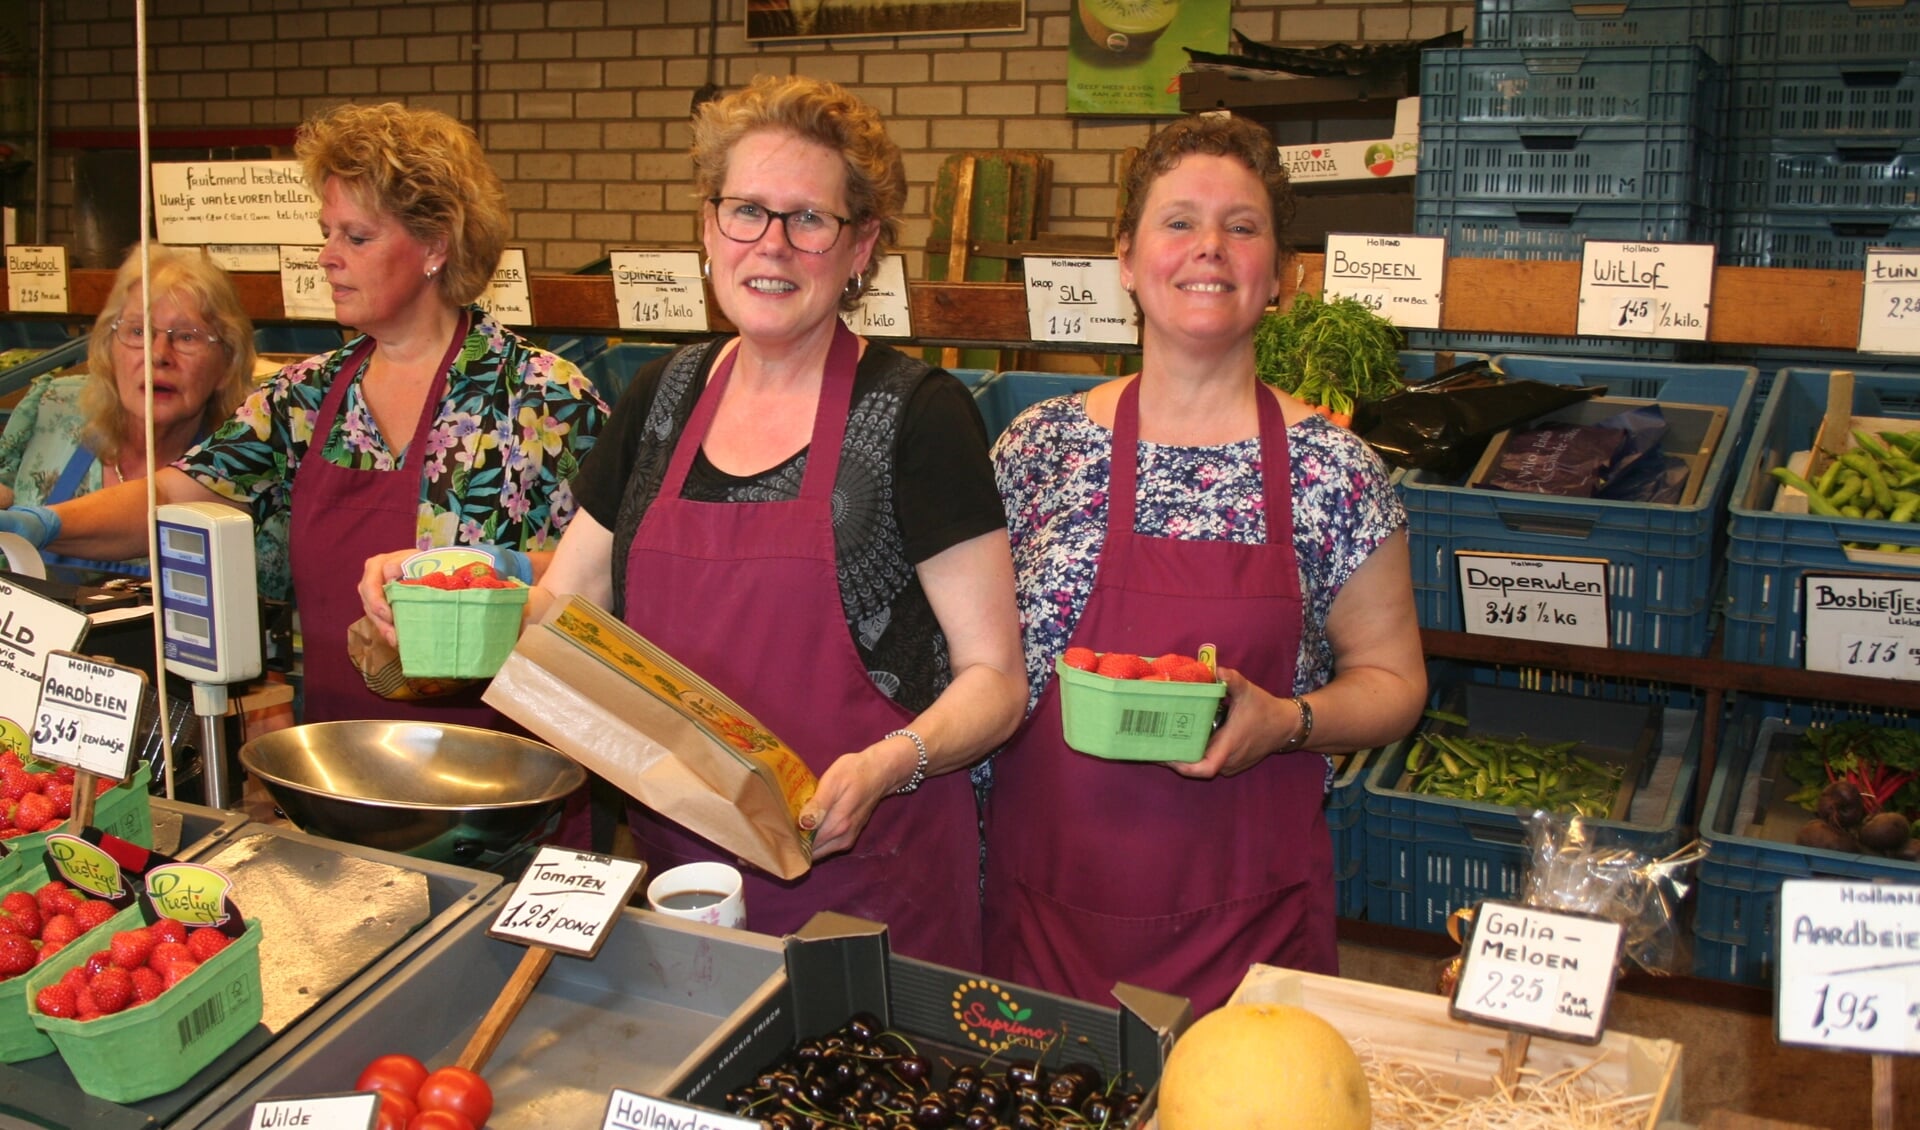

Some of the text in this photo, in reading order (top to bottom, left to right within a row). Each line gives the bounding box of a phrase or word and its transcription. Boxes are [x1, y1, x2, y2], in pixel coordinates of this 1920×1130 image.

[148, 873, 231, 926] Prestige
[963, 1001, 1047, 1039] Suprimo
[686, 1072, 711, 1102] FRESH
[718, 1034, 752, 1071] KNACKIG
[754, 1007, 780, 1037] FRISCH
